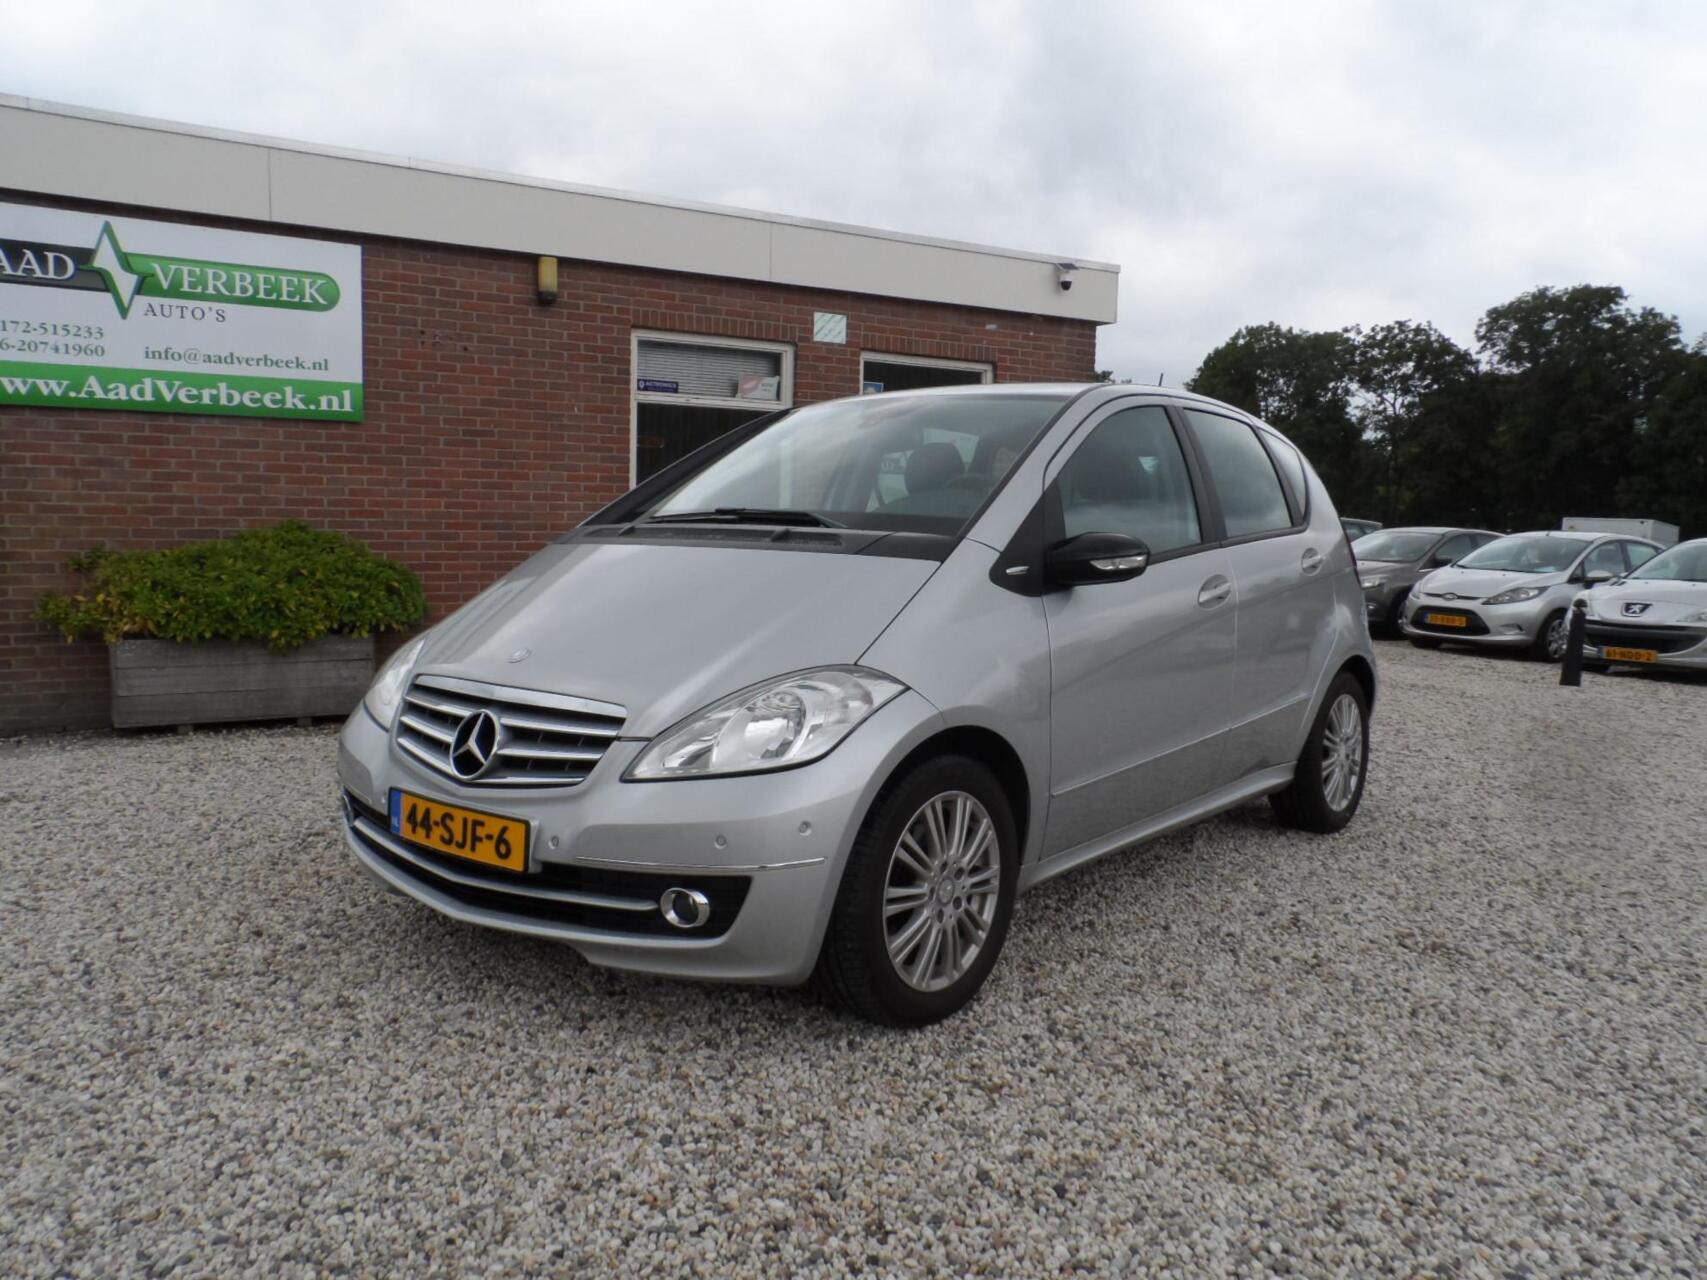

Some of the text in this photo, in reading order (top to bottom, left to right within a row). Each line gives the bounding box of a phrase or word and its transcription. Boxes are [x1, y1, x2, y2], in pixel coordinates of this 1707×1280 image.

[152, 263, 328, 304] VERBEEK
[144, 303, 226, 323] AUTO'S
[144, 346, 329, 371] info@aadverbeek.nl
[406, 803, 511, 860] 44-SJF-6
